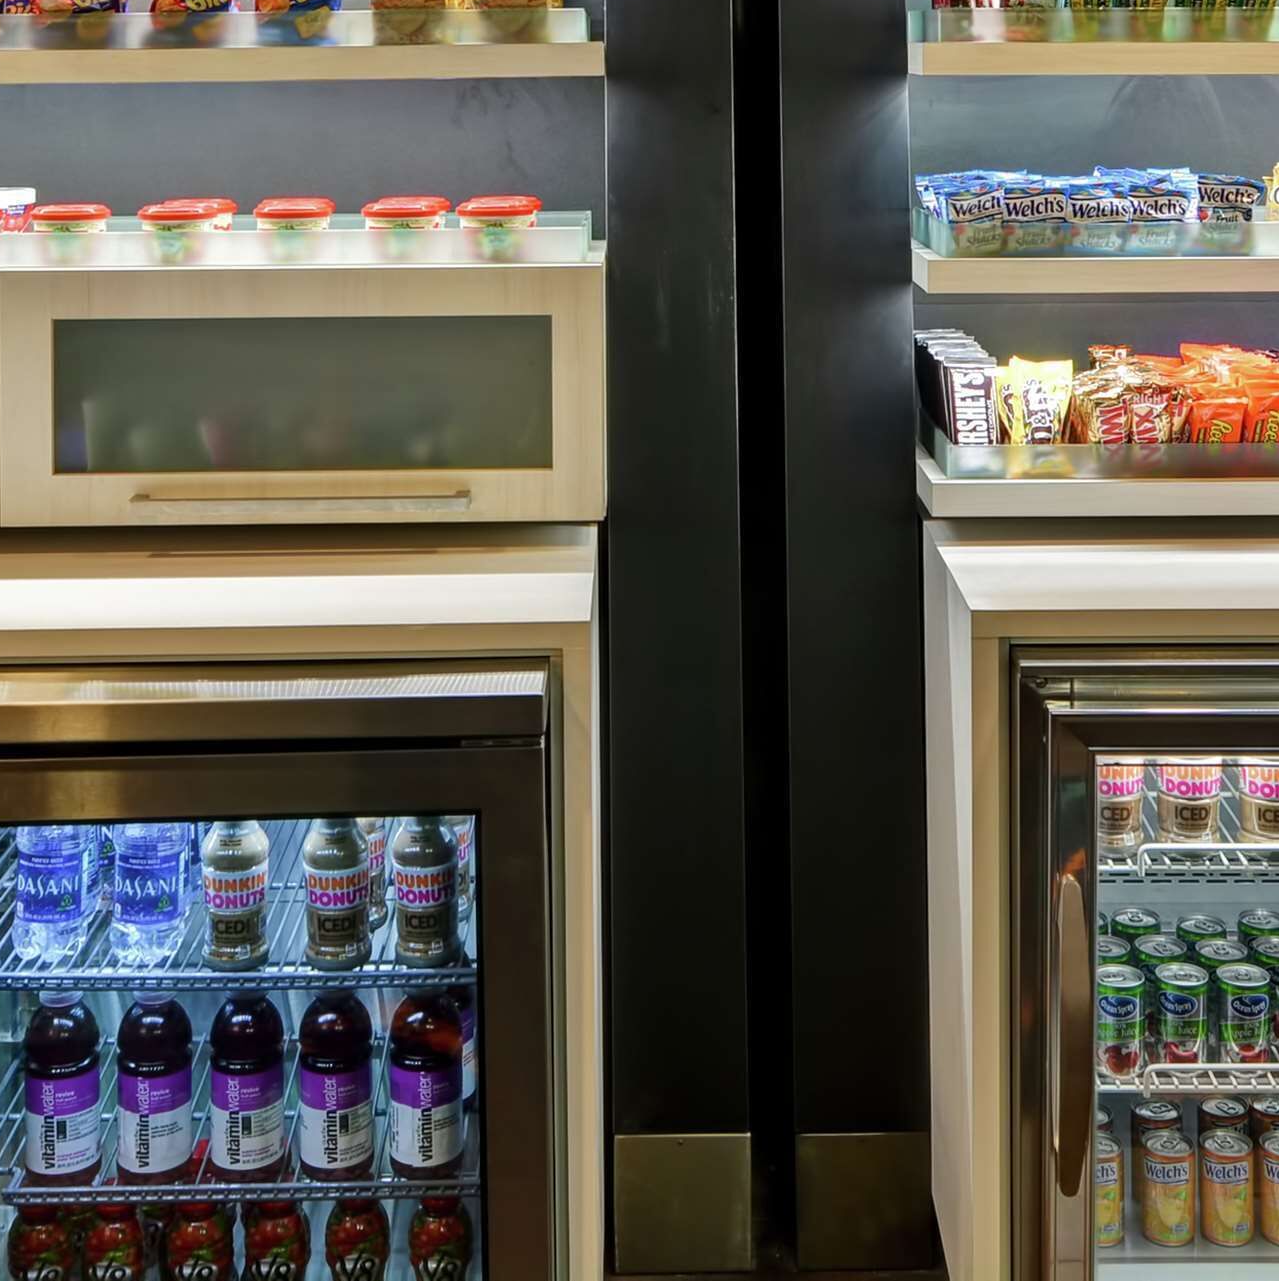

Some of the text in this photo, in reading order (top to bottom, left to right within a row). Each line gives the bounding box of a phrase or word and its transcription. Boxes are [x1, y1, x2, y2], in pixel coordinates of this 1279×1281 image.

[1197, 185, 1256, 205] Welch's
[950, 195, 1003, 218] Welch
[1004, 196, 1065, 218] Welch's
[1071, 199, 1130, 219] Welch's
[1132, 198, 1187, 218] Welch's
[954, 372, 989, 445] RSHEY'S
[1133, 392, 1168, 405] RIGHT
[18, 873, 80, 899] DASANI
[115, 873, 177, 899] DASANI
[204, 886, 265, 908] DONUTS
[405, 913, 437, 929] ICED
[1232, 999, 1250, 1015] Ocean
[41, 1081, 55, 1169] vitaminwater
[137, 1078, 150, 1168] vitaminwater
[226, 1077, 240, 1165] vitaminwater
[324, 1077, 338, 1164] vitaminwater
[418, 1072, 432, 1162] vitaminwater
[1145, 1163, 1188, 1180] Welch's
[1205, 1163, 1248, 1180] Welch's
